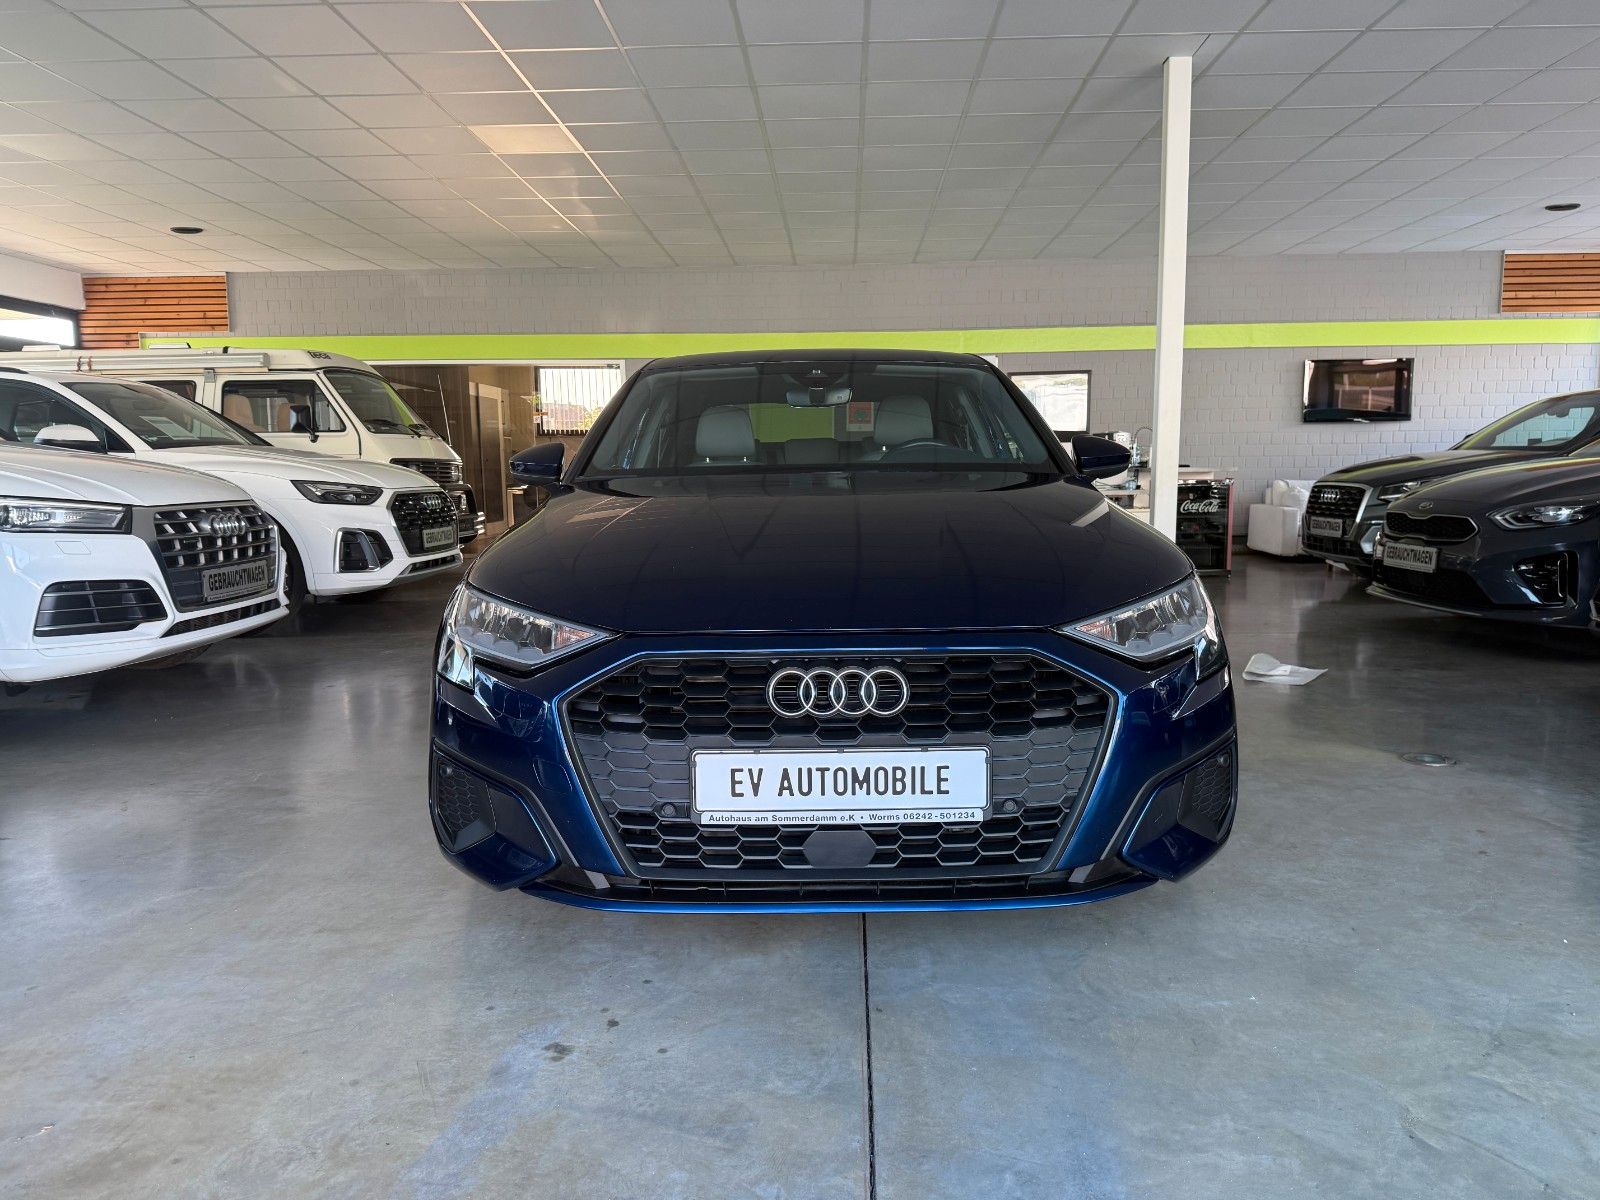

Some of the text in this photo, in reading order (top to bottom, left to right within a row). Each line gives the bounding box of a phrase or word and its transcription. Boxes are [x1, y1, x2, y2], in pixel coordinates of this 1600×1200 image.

[1386, 545, 1433, 566] GEBRAUCHTWAGEN
[208, 564, 266, 592] GEBRAUCHTWAGEN
[730, 765, 950, 798] EV AUTOMOBILE
[708, 814, 752, 822] Autohaus
[771, 814, 837, 822] Sommerdamm
[840, 814, 856, 822] e.K
[868, 813, 900, 821] Worms
